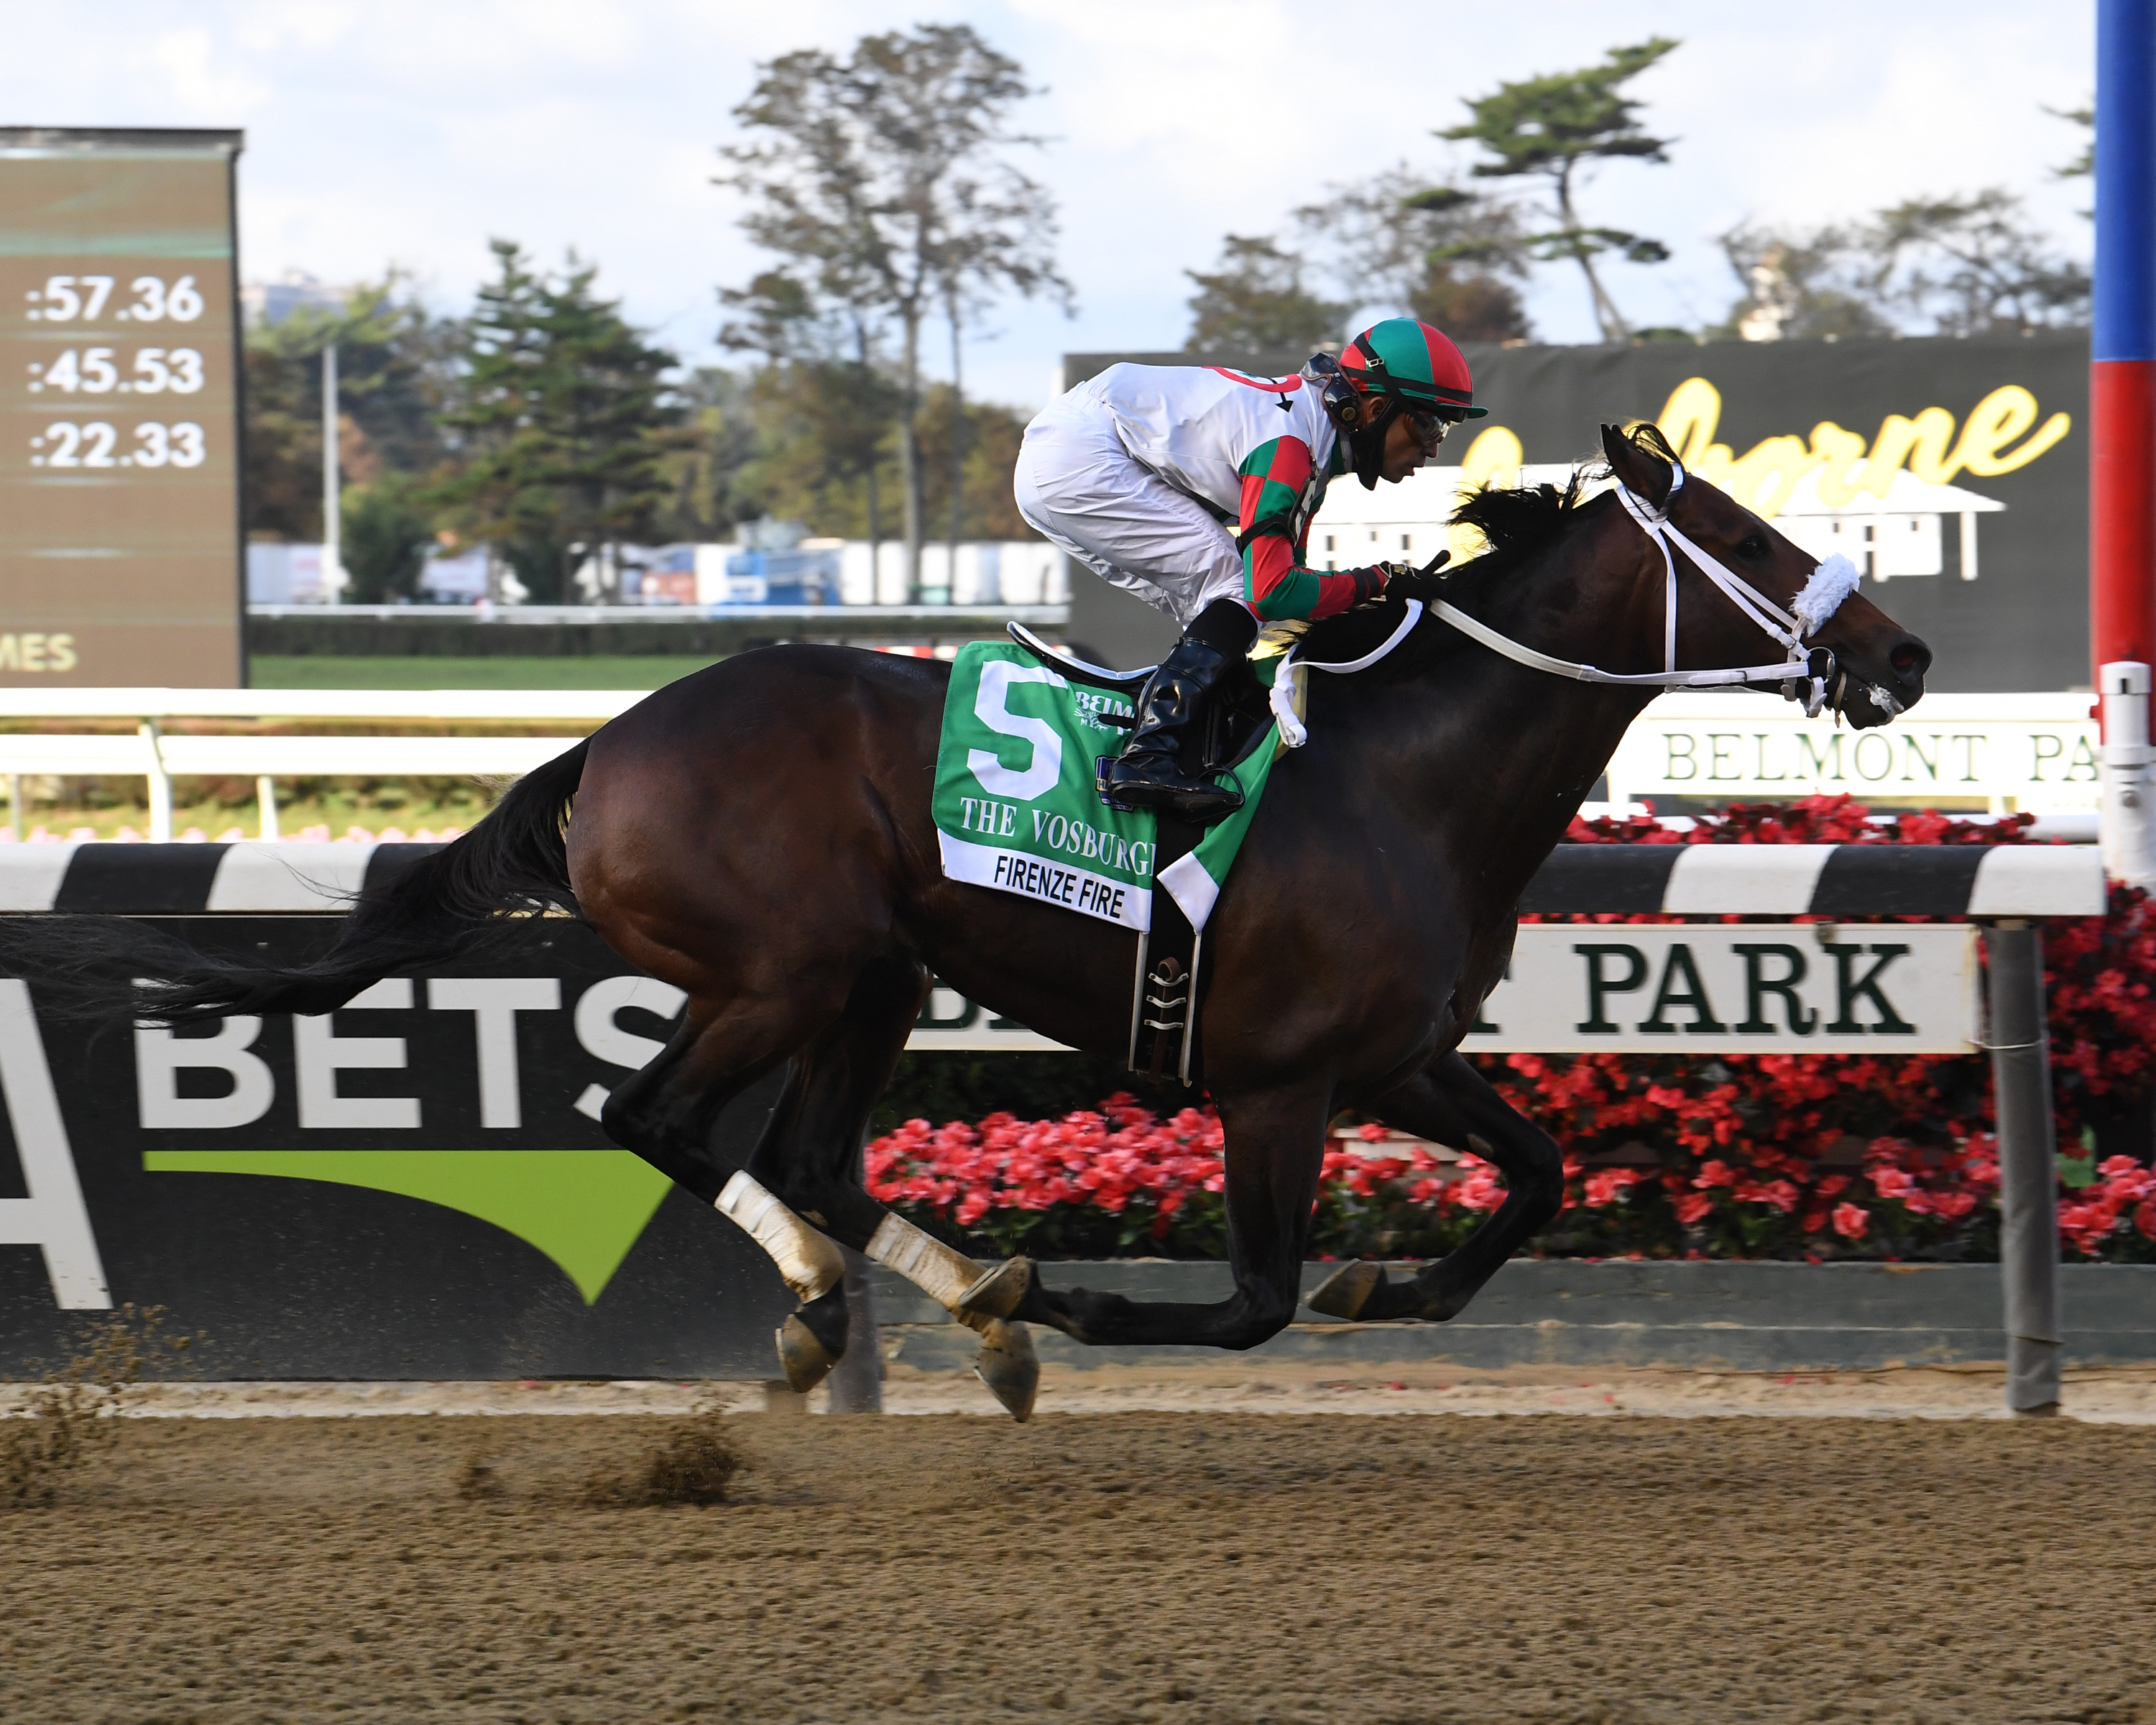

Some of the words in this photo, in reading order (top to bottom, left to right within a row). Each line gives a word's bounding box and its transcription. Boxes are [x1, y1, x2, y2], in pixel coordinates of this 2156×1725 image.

[26, 276, 204, 321] :57.36
[28, 348, 205, 394] :45.53
[29, 422, 206, 468] :22.33
[967, 660, 1068, 801] 5
[1662, 733, 1989, 782] BELMONT
[2028, 735, 2099, 782] PA
[960, 796, 1017, 837] THE
[994, 855, 1077, 904] FIRENZE
[1078, 878, 1125, 919] FIRE
[1572, 942, 1917, 1036] PARK
[131, 975, 688, 1129] BETS
